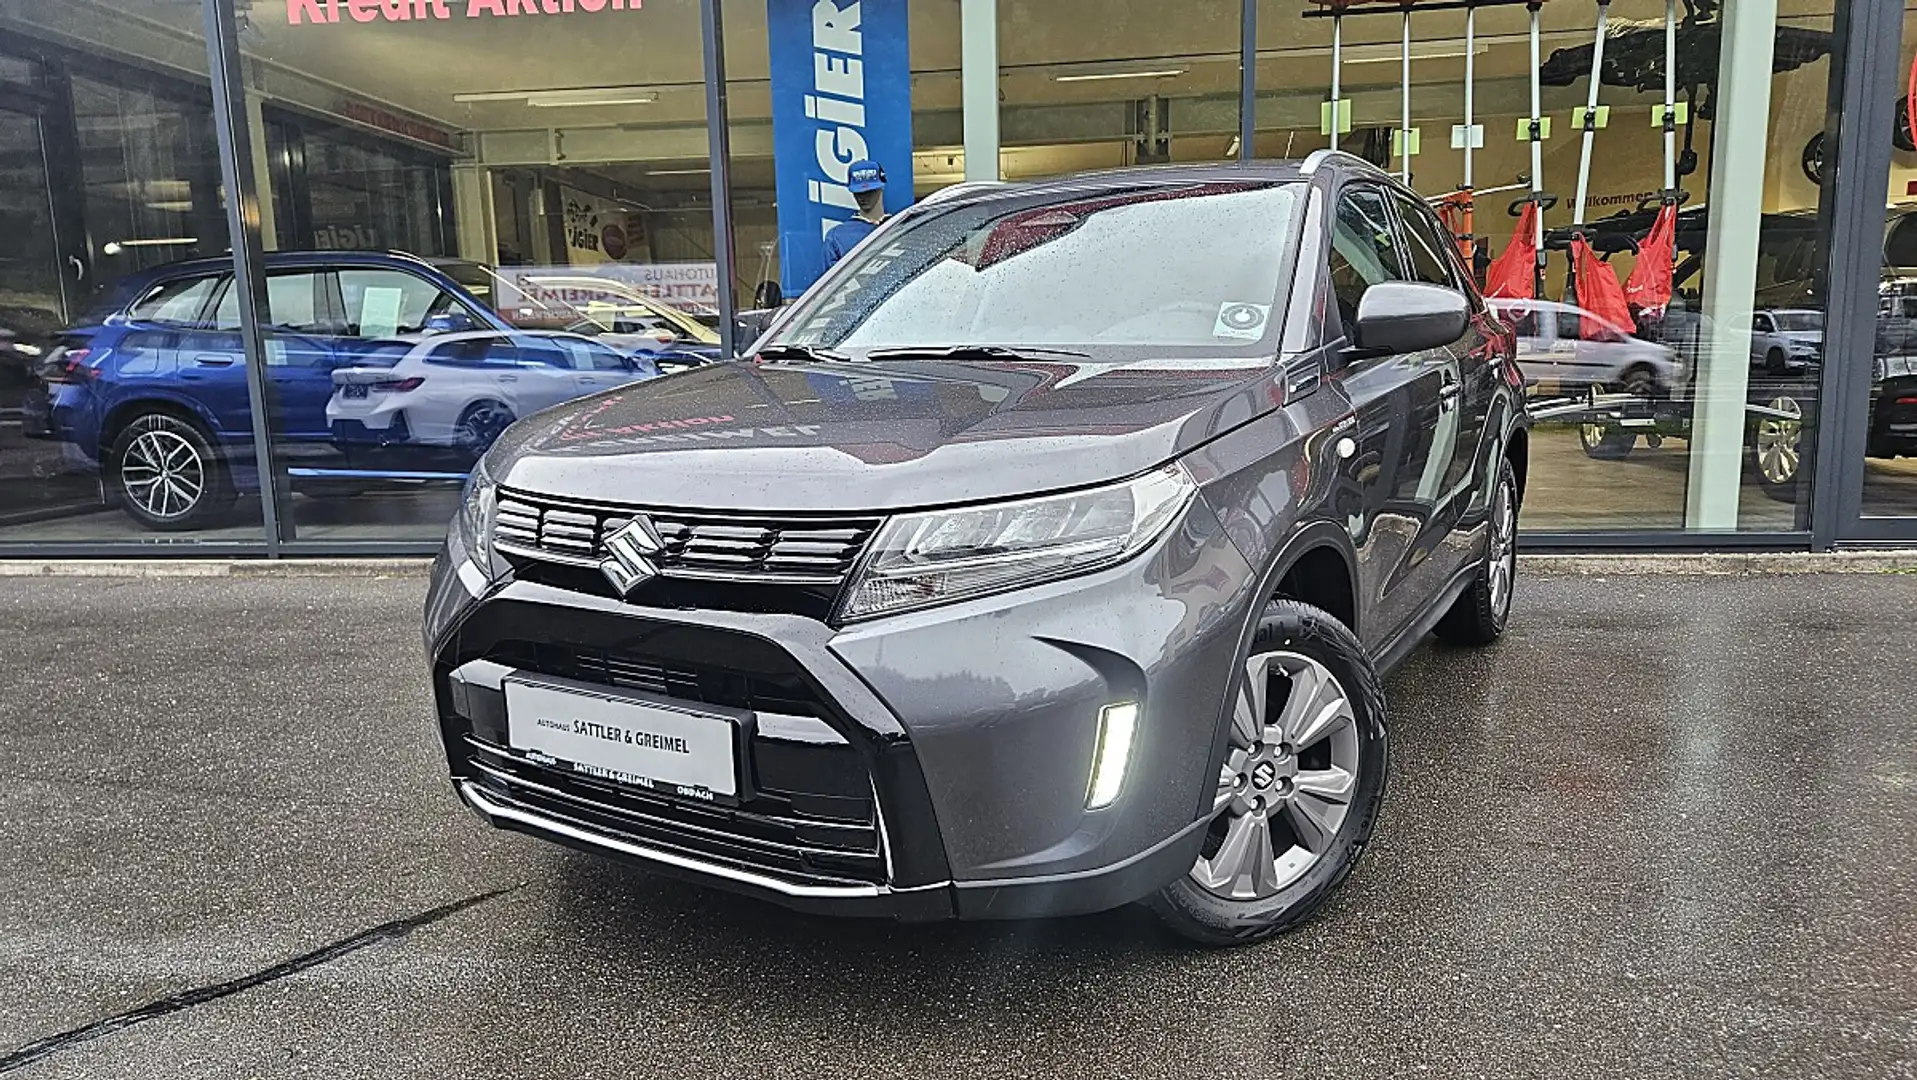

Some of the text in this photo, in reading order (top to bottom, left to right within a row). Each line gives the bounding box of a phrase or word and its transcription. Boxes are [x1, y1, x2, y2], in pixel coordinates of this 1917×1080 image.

[573, 719, 621, 743] SATTLER
[624, 729, 633, 744] &
[635, 731, 690, 754] GREIMEL
